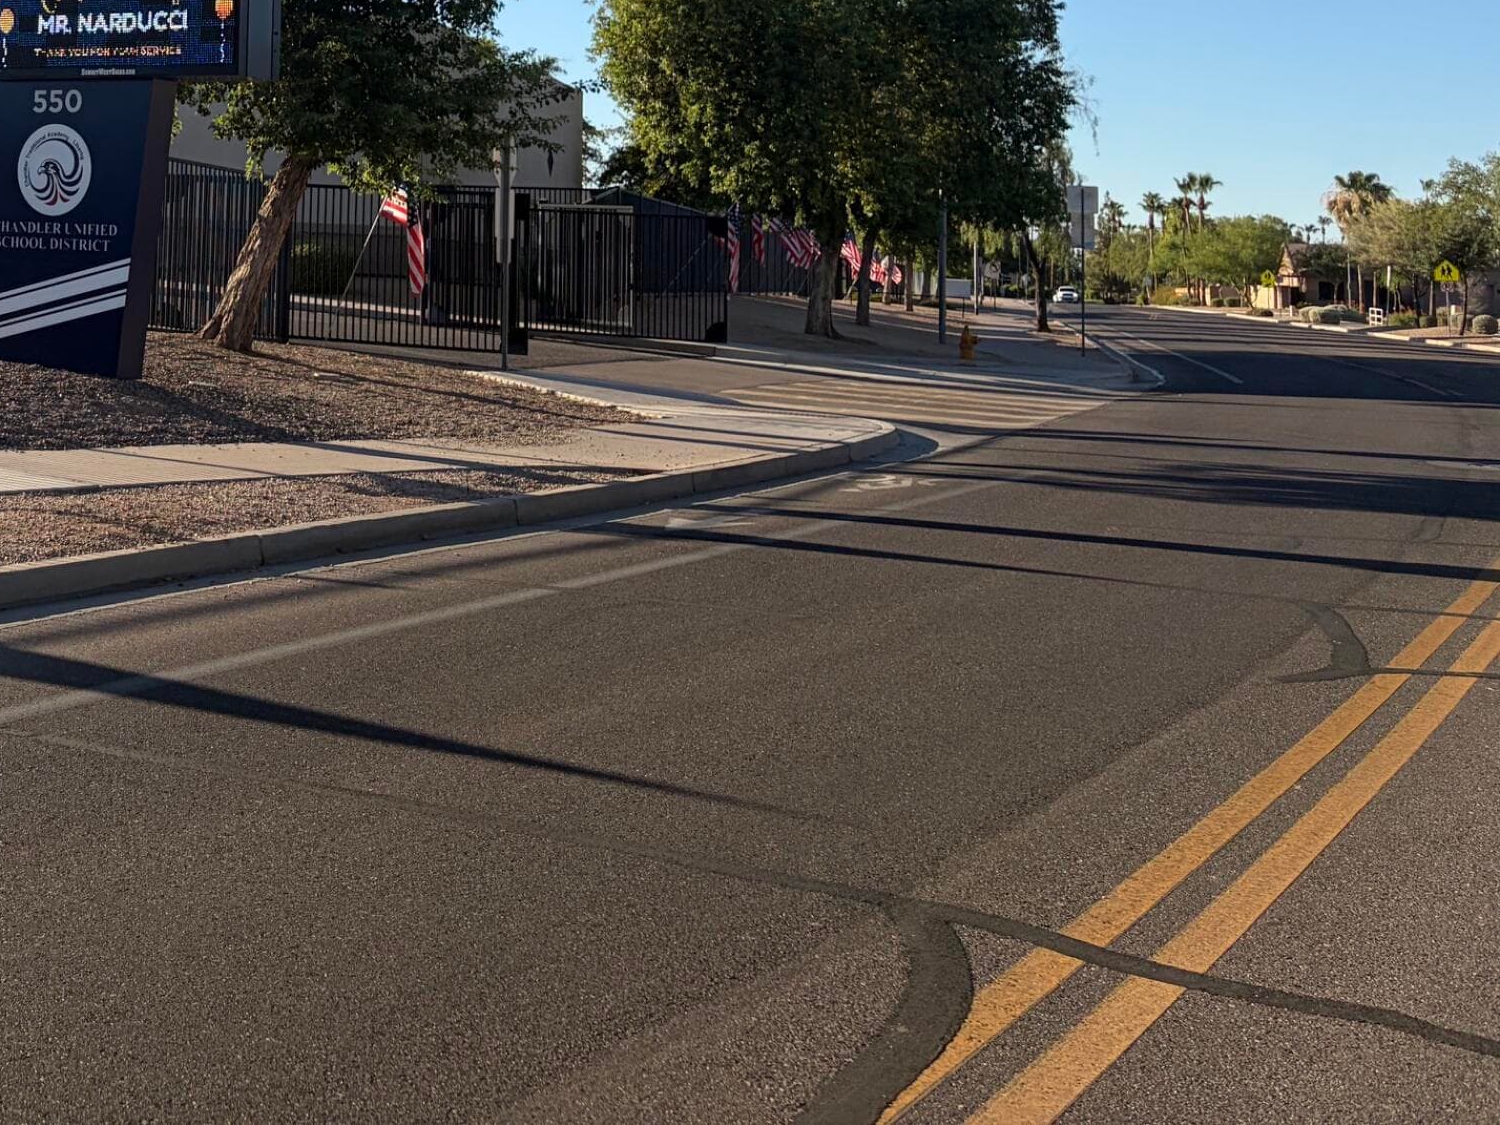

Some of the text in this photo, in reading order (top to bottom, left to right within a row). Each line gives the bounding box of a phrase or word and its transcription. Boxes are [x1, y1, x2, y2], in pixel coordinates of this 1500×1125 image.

[37, 9, 189, 35] MR. NARDUCCI
[32, 89, 83, 114] 550
[64, 221, 118, 236] UNIFIED
[50, 237, 111, 252] DISTRICT
